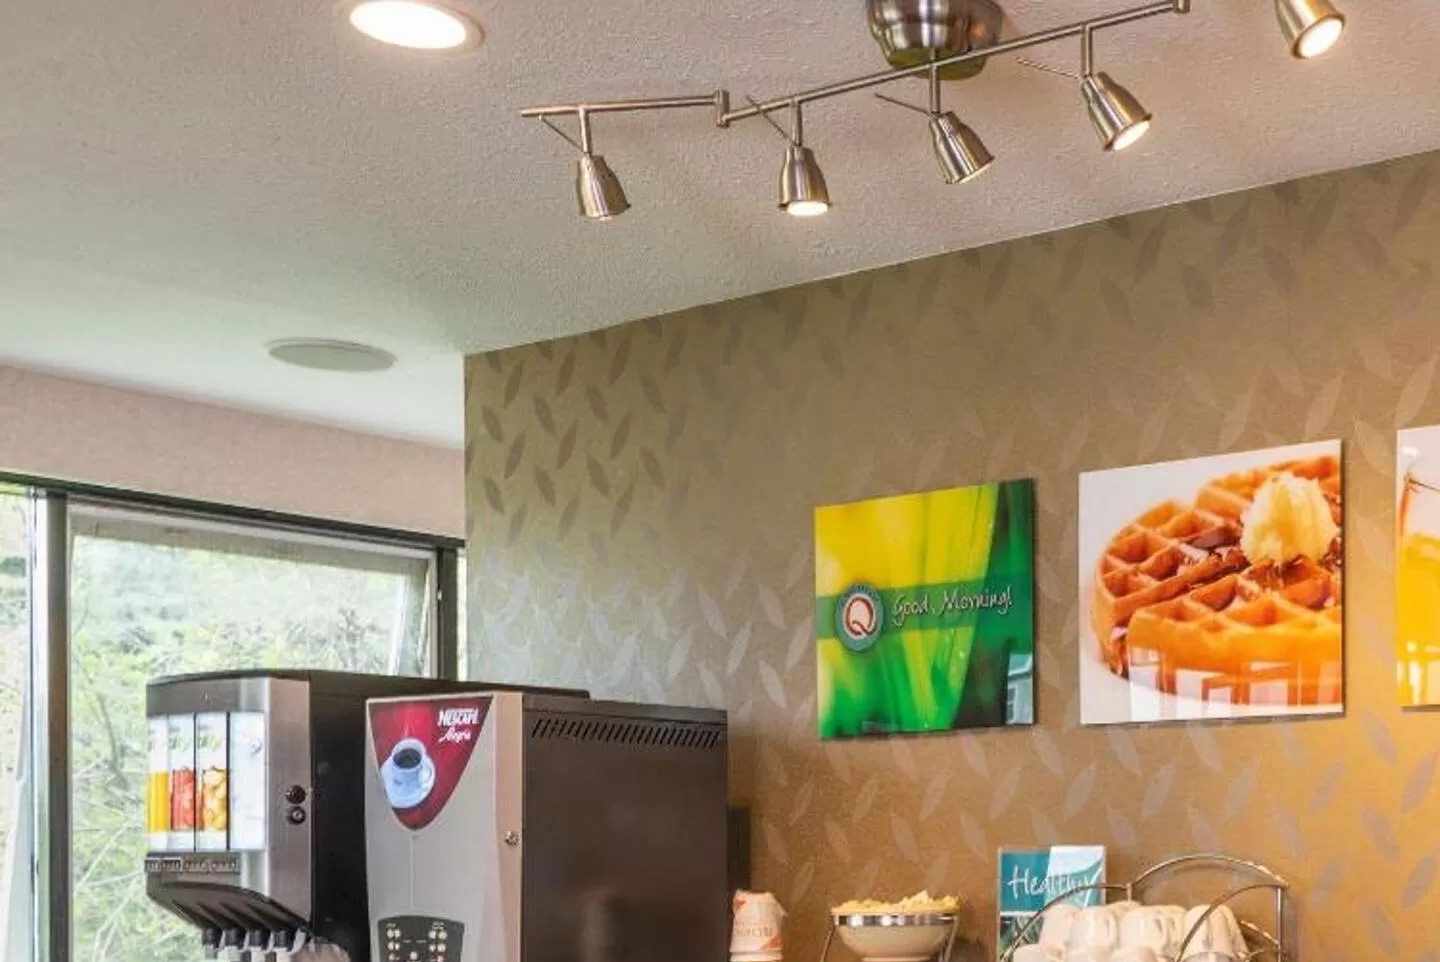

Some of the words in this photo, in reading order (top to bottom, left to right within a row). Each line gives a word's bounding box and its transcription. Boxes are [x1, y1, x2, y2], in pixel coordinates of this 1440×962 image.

[846, 597, 876, 636] Q
[892, 593, 930, 628] Good
[933, 586, 1013, 617] Morning!
[1007, 864, 1103, 907] Healthy
